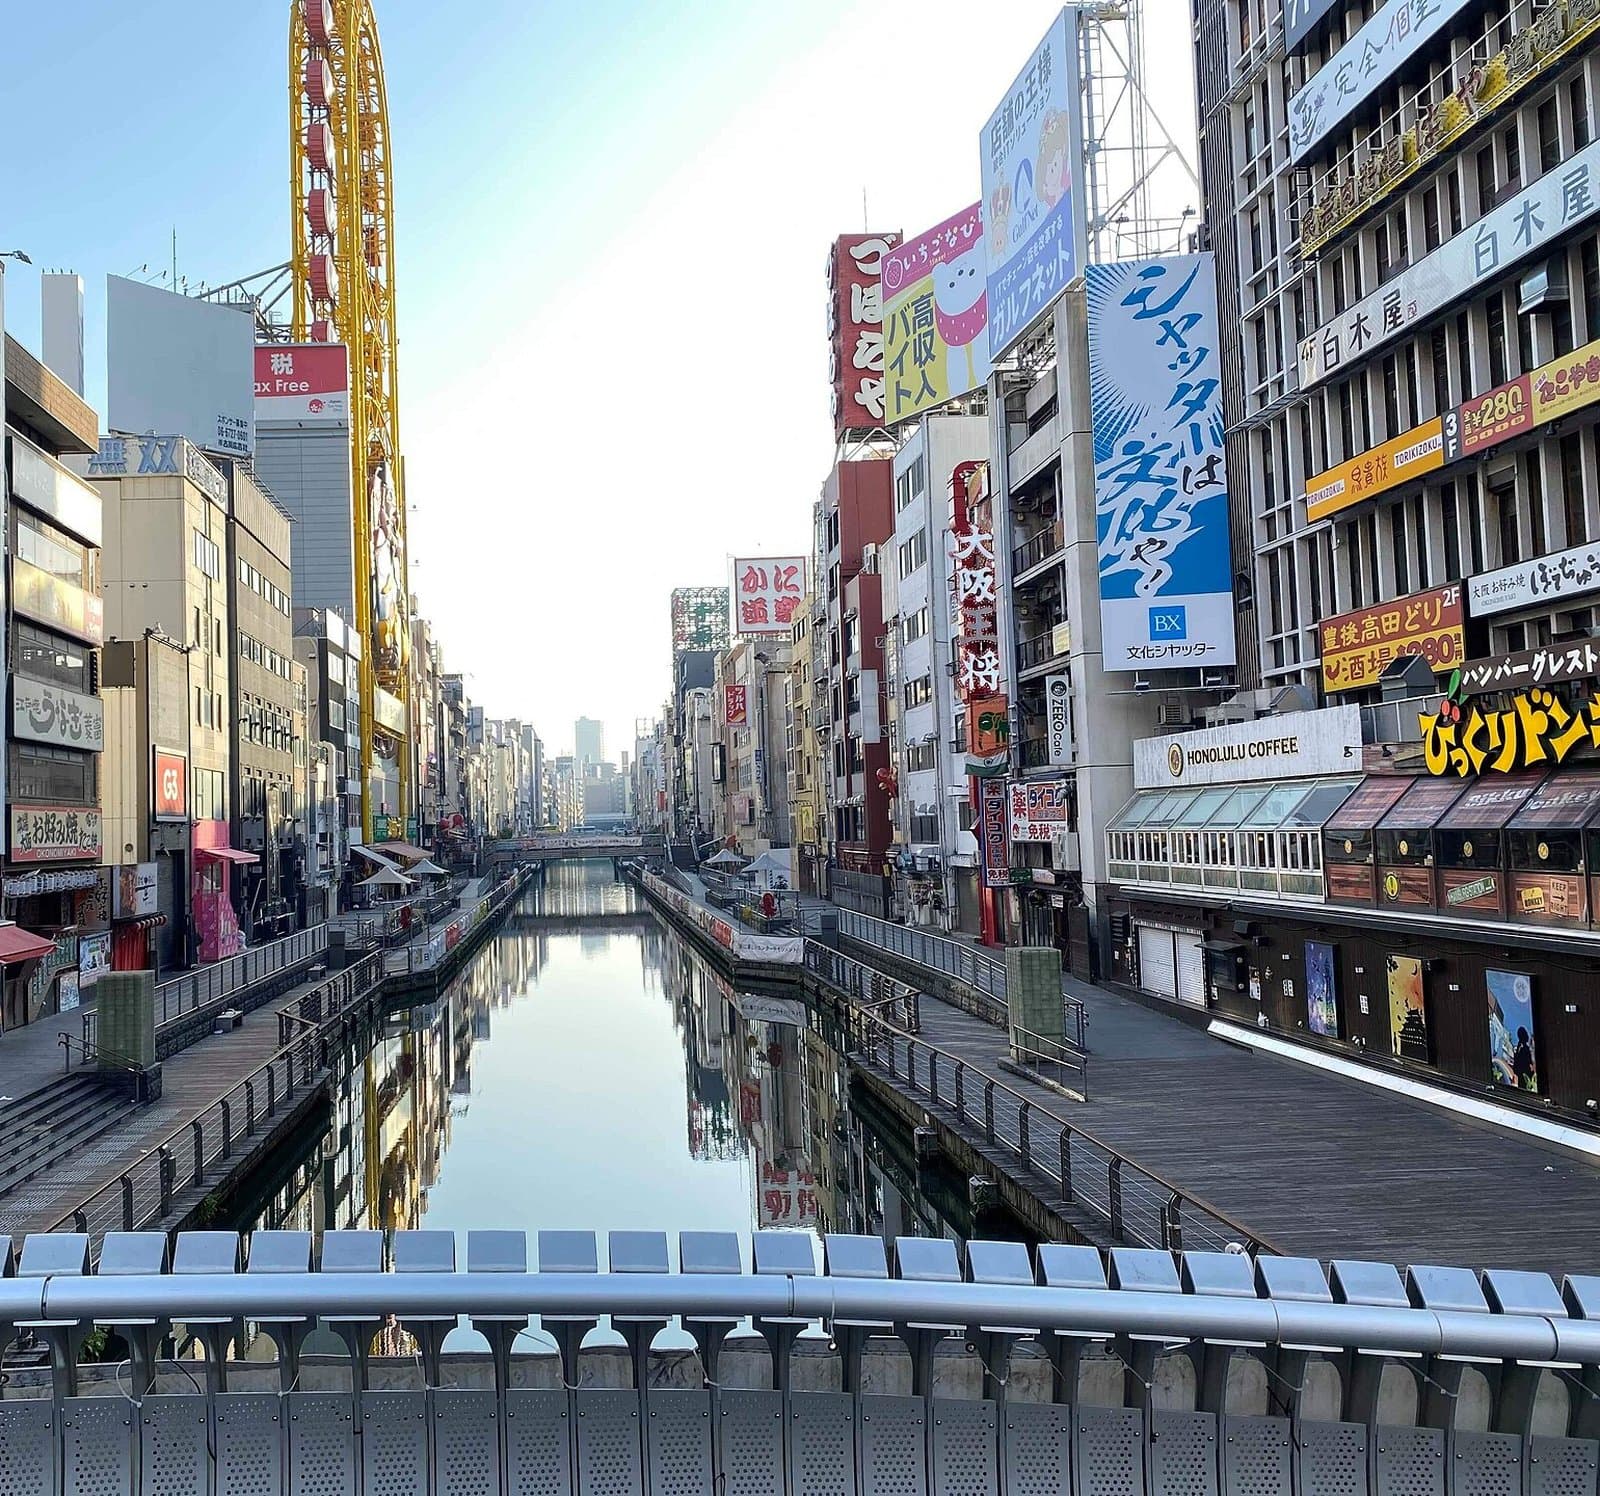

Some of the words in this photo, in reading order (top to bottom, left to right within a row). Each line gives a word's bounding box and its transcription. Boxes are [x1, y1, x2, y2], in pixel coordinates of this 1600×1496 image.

[1474, 163, 1594, 277] 白木屋
[904, 215, 976, 270] いちごなび
[993, 239, 1070, 345] ガルフネット
[1323, 288, 1404, 372] 白木屋
[887, 297, 912, 414] バイト
[911, 290, 936, 405] 高収入
[275, 379, 310, 392] Free
[88, 438, 178, 473] 無双
[1395, 439, 1439, 466] TORIKIZOKU
[1351, 453, 1388, 494] 鳥貴族
[1307, 482, 1342, 505] TORIKIZOKU
[741, 565, 800, 593] かに
[741, 596, 800, 624] 道楽
[956, 524, 1000, 691] 大阪王将
[1443, 586, 1460, 607] 2F
[1154, 614, 1182, 632] BX
[1323, 598, 1442, 649] 豊後高田どり
[1342, 648, 1393, 682] 酒場
[1462, 644, 1598, 687] ハンバーグレスト
[29, 689, 82, 740] うなぎ
[735, 686, 745, 711] ツルハ
[1187, 744, 1246, 765] HONOLULU
[1249, 736, 1299, 758] COFFEE
[163, 768, 178, 800] G3
[33, 811, 78, 844] お好み焼
[987, 800, 1003, 844] ダイコク
[1028, 824, 1051, 840] 免税
[988, 869, 1009, 880] 免税
[1551, 881, 1567, 891] KEEP
[1550, 901, 1568, 914] RIGHT
